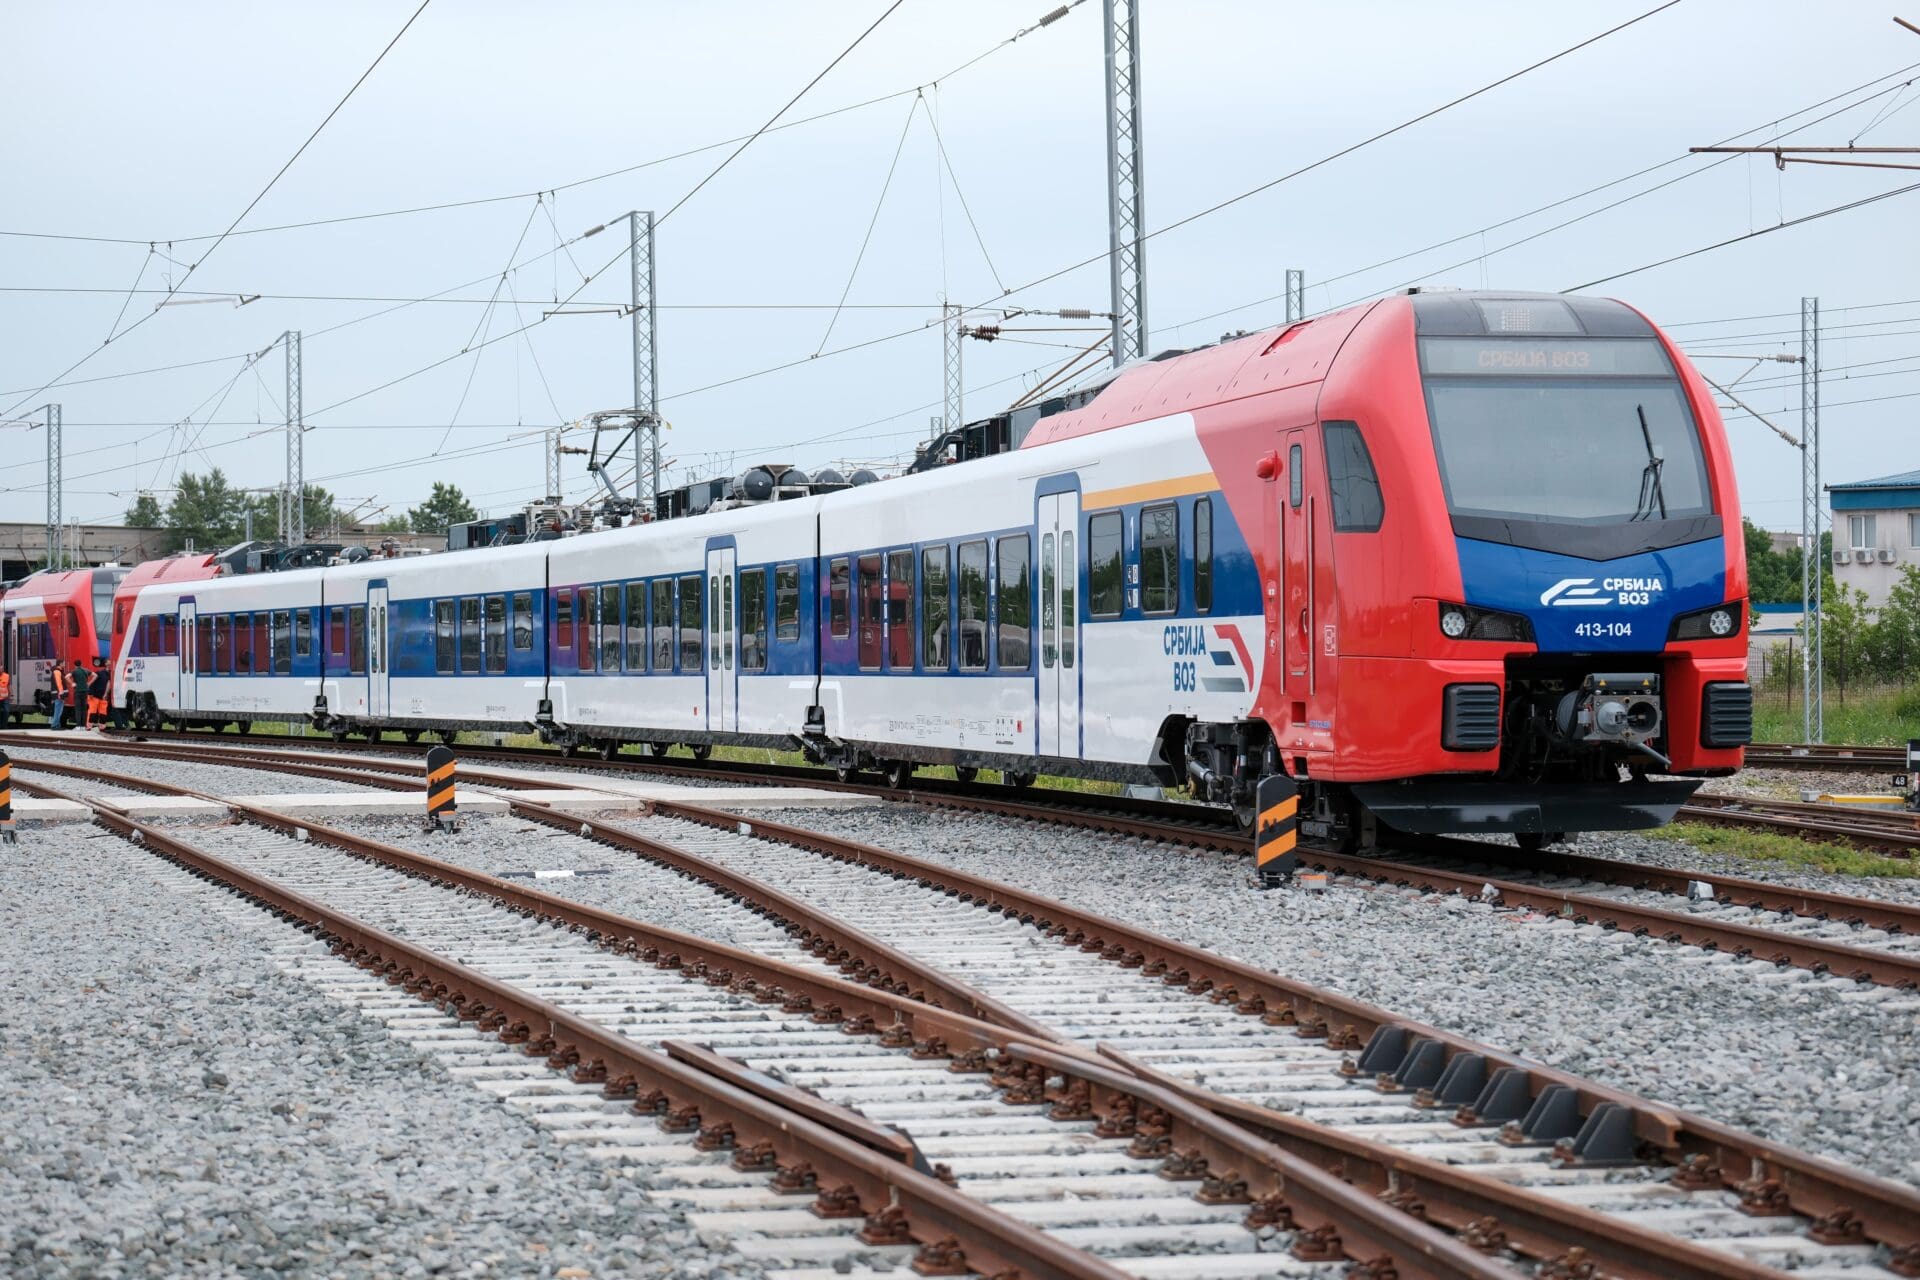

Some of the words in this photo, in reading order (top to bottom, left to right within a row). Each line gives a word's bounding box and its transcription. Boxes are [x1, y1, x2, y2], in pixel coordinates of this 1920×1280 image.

[1479, 351, 1547, 368] СРБИЈА
[1551, 351, 1589, 368] ВОЗ
[1603, 578, 1662, 591] СРБИЈА
[1619, 592, 1649, 605] ВОЗ
[1574, 623, 1632, 636] 413-104
[1164, 625, 1206, 655] СРБИЈА
[1174, 661, 1196, 692] ВОЗ
[1895, 776, 1905, 785] 48
